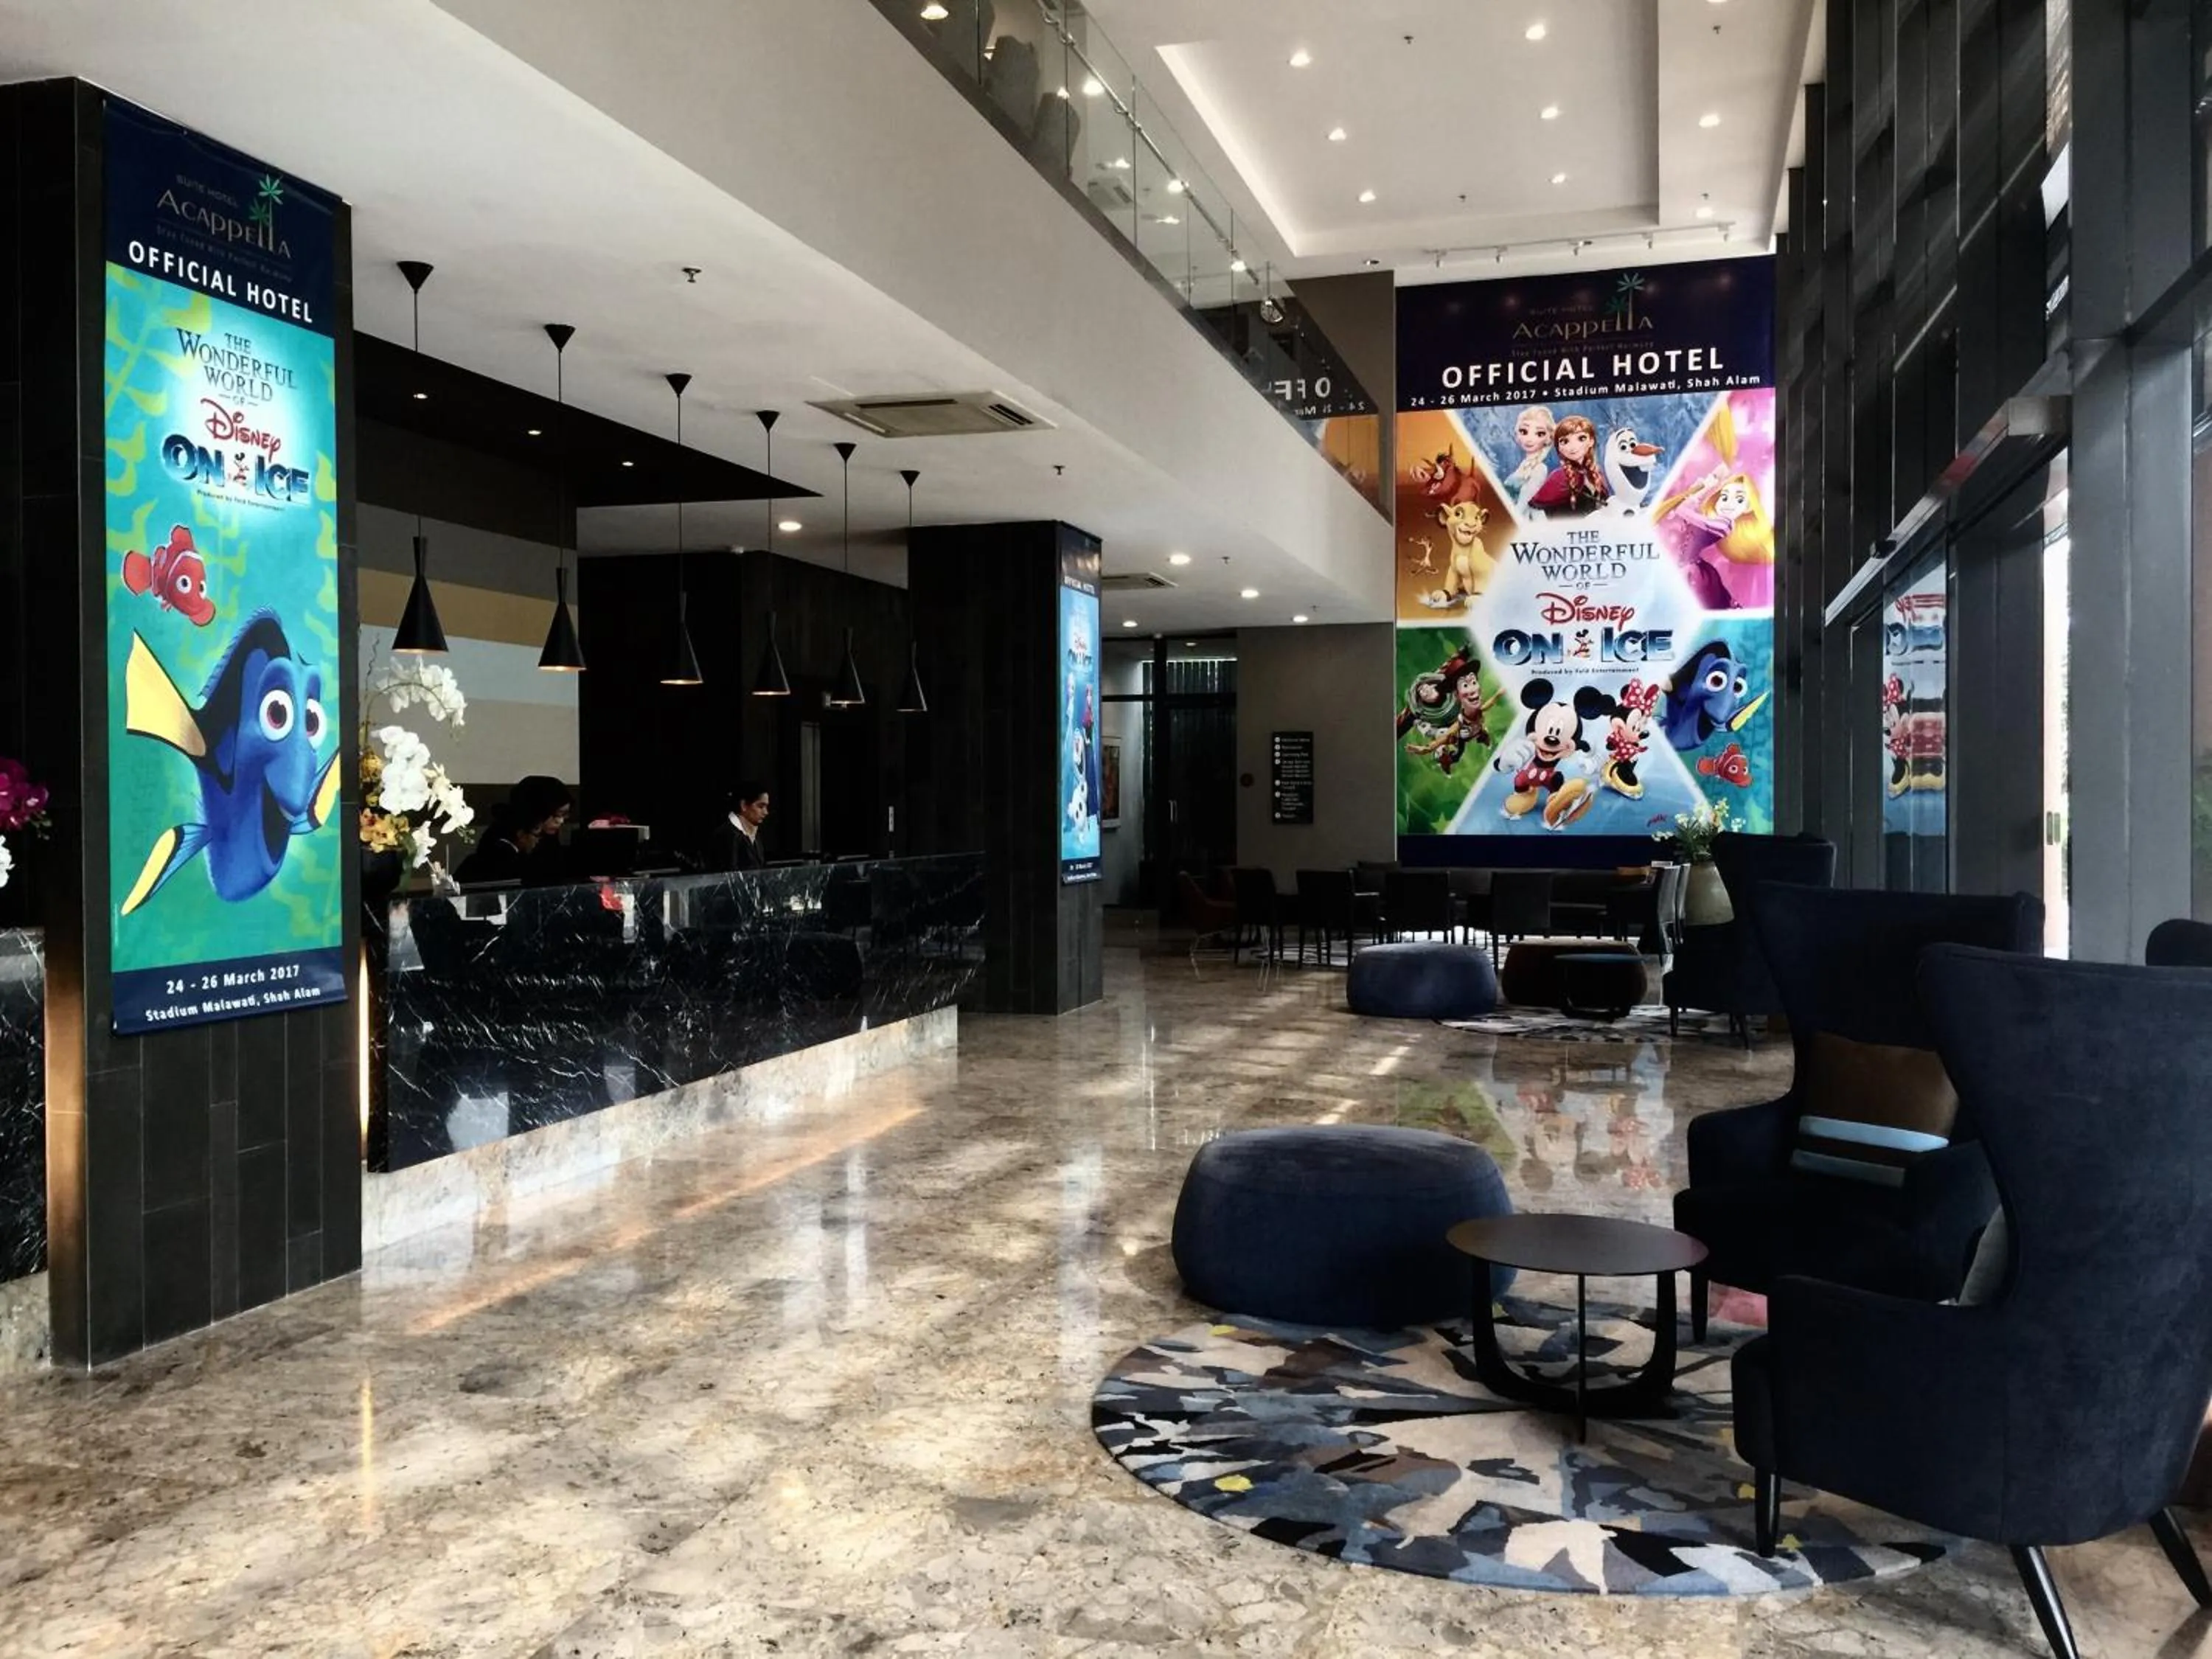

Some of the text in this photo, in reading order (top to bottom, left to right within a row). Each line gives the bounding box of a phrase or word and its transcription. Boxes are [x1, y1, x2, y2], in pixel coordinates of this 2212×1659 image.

[128, 240, 313, 323] OFFICIAL HOTEL
[176, 327, 298, 389] WONDERFUL
[224, 332, 252, 354] THE
[204, 364, 274, 402] WORLD
[1441, 347, 1724, 389] OFFICIAL HOTEL
[1411, 396, 1425, 406] 24
[1440, 394, 1455, 405] 26
[1461, 392, 1500, 403] March
[1506, 389, 1537, 400] 2017
[1554, 384, 1609, 397] Stadium
[1687, 375, 1719, 389] Shah
[1725, 374, 1761, 385] Alam
[162, 434, 310, 502] ON ICE
[1510, 542, 1660, 565] WONDERFUL
[1567, 530, 1599, 544] THE
[1542, 563, 1627, 582] WORLD
[1576, 581, 1591, 590] OF
[1492, 627, 1674, 666] ON ICE
[167, 979, 184, 995] 24
[201, 975, 218, 990] 26
[223, 969, 265, 987] March
[270, 964, 300, 981] 2017
[145, 1004, 198, 1022] Stadium
[263, 989, 290, 1004] Shah
[294, 986, 321, 999] Alam
